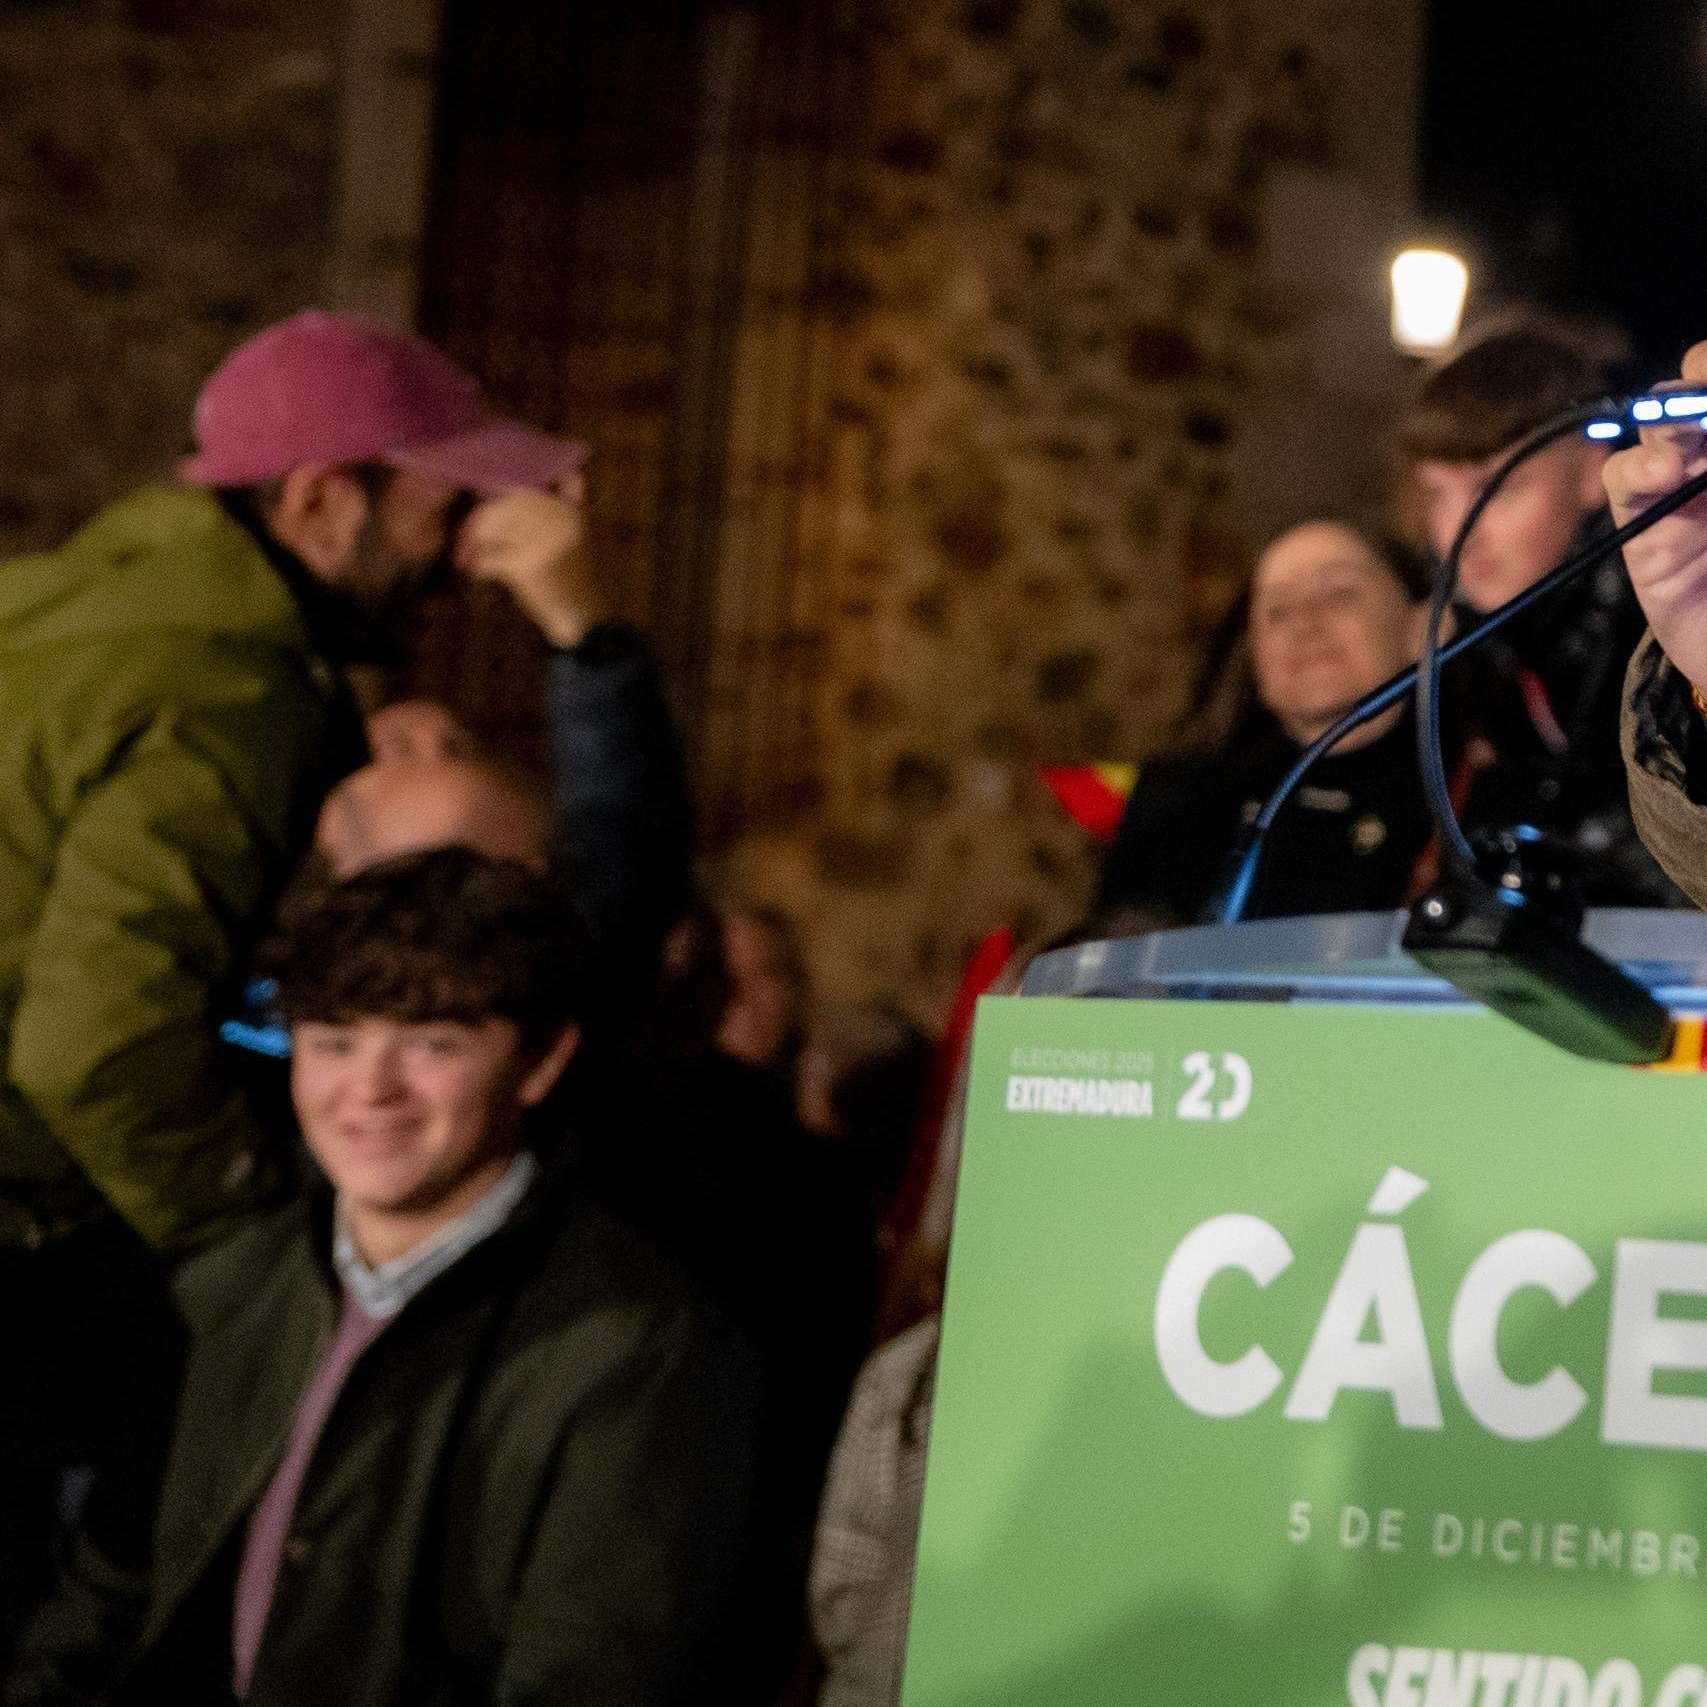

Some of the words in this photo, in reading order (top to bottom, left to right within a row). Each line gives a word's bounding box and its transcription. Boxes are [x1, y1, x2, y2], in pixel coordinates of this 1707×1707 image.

[1005, 1075, 1154, 1116] EXTREMADURA
[1287, 1499, 1312, 1544] 5
[1339, 1505, 1404, 1553] DE
